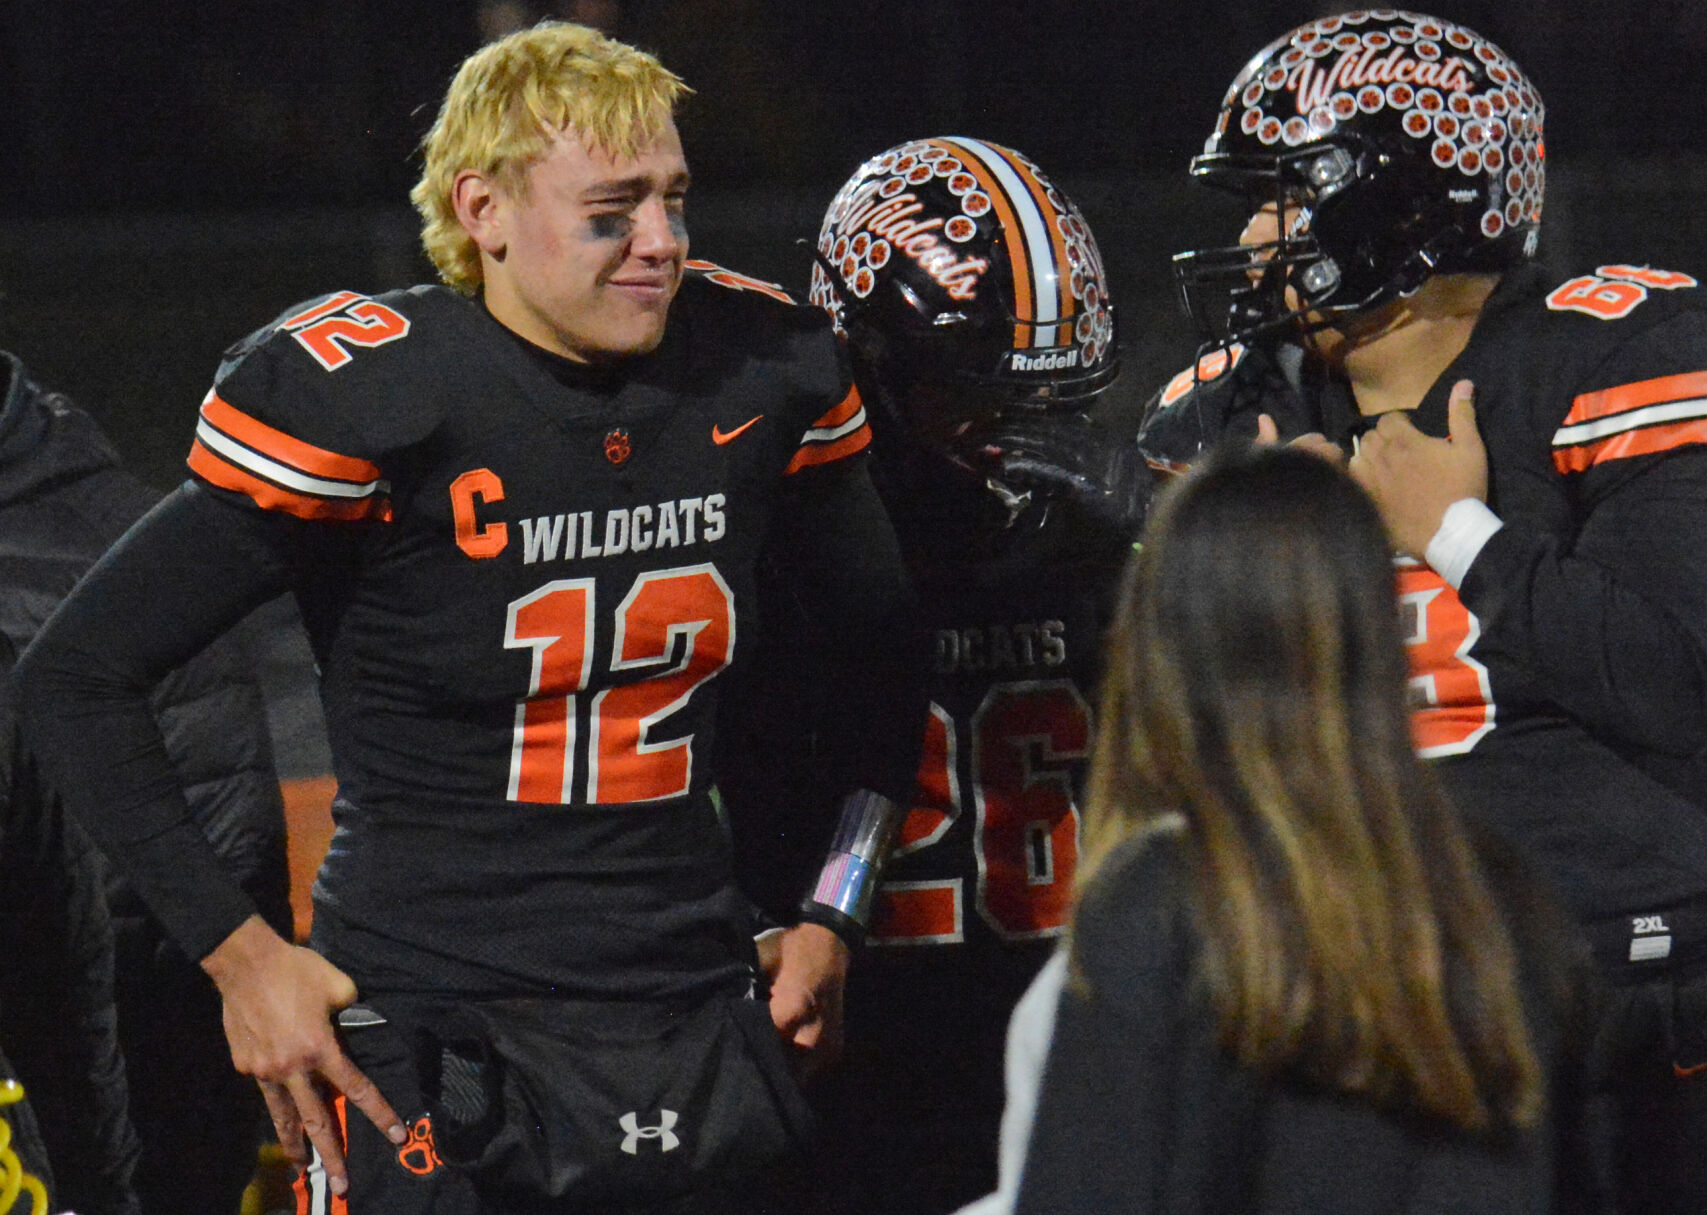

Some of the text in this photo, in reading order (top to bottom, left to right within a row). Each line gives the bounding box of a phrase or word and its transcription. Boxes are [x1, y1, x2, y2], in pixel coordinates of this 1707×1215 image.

[1286, 46, 1474, 114] Wildcats
[836, 179, 987, 300] Wildcats
[275, 290, 411, 372] 12
[1011, 350, 1077, 371] Riddell
[450, 467, 509, 559] C
[519, 493, 726, 564] WILDCATS
[934, 618, 1066, 674] DCATS
[503, 562, 736, 804] 12
[1632, 915, 1670, 934] 2XL
